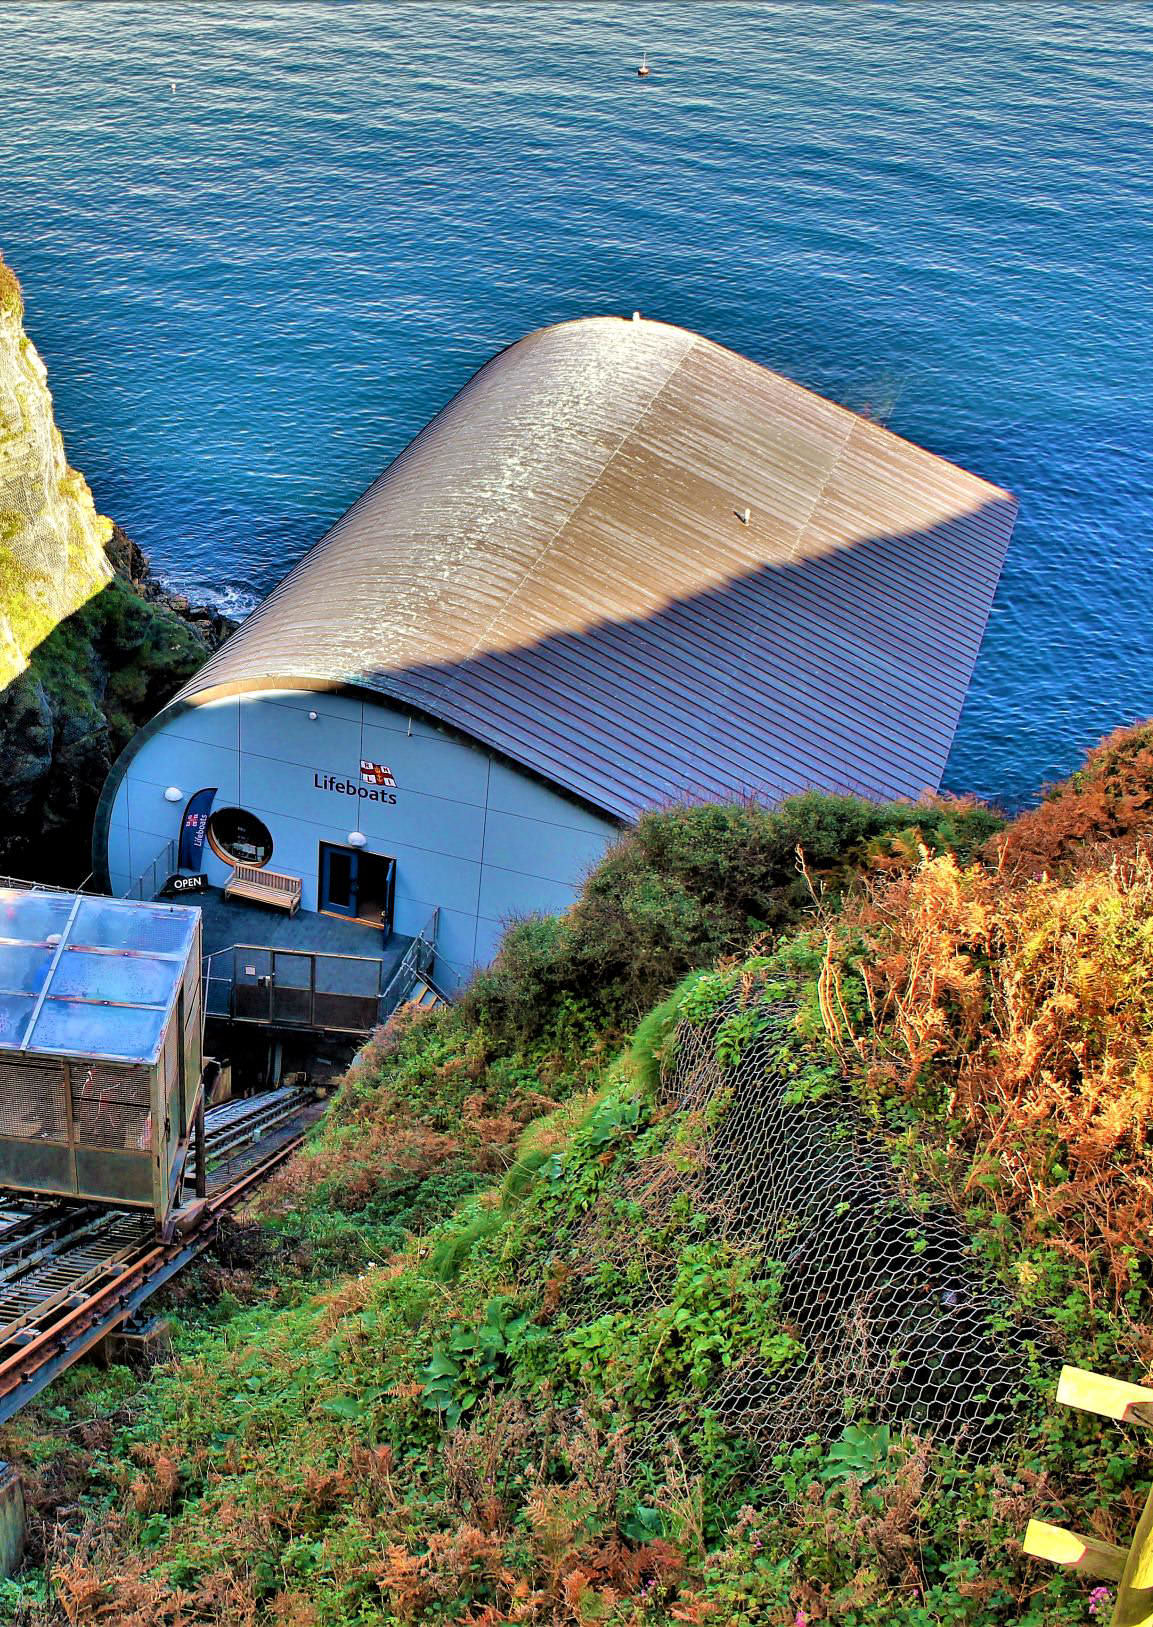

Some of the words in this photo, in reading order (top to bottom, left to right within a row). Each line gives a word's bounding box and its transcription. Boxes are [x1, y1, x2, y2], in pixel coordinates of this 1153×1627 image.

[314, 773, 397, 805] Lifeboats
[194, 814, 208, 848] Lifeboats
[174, 876, 202, 889] OPEN
